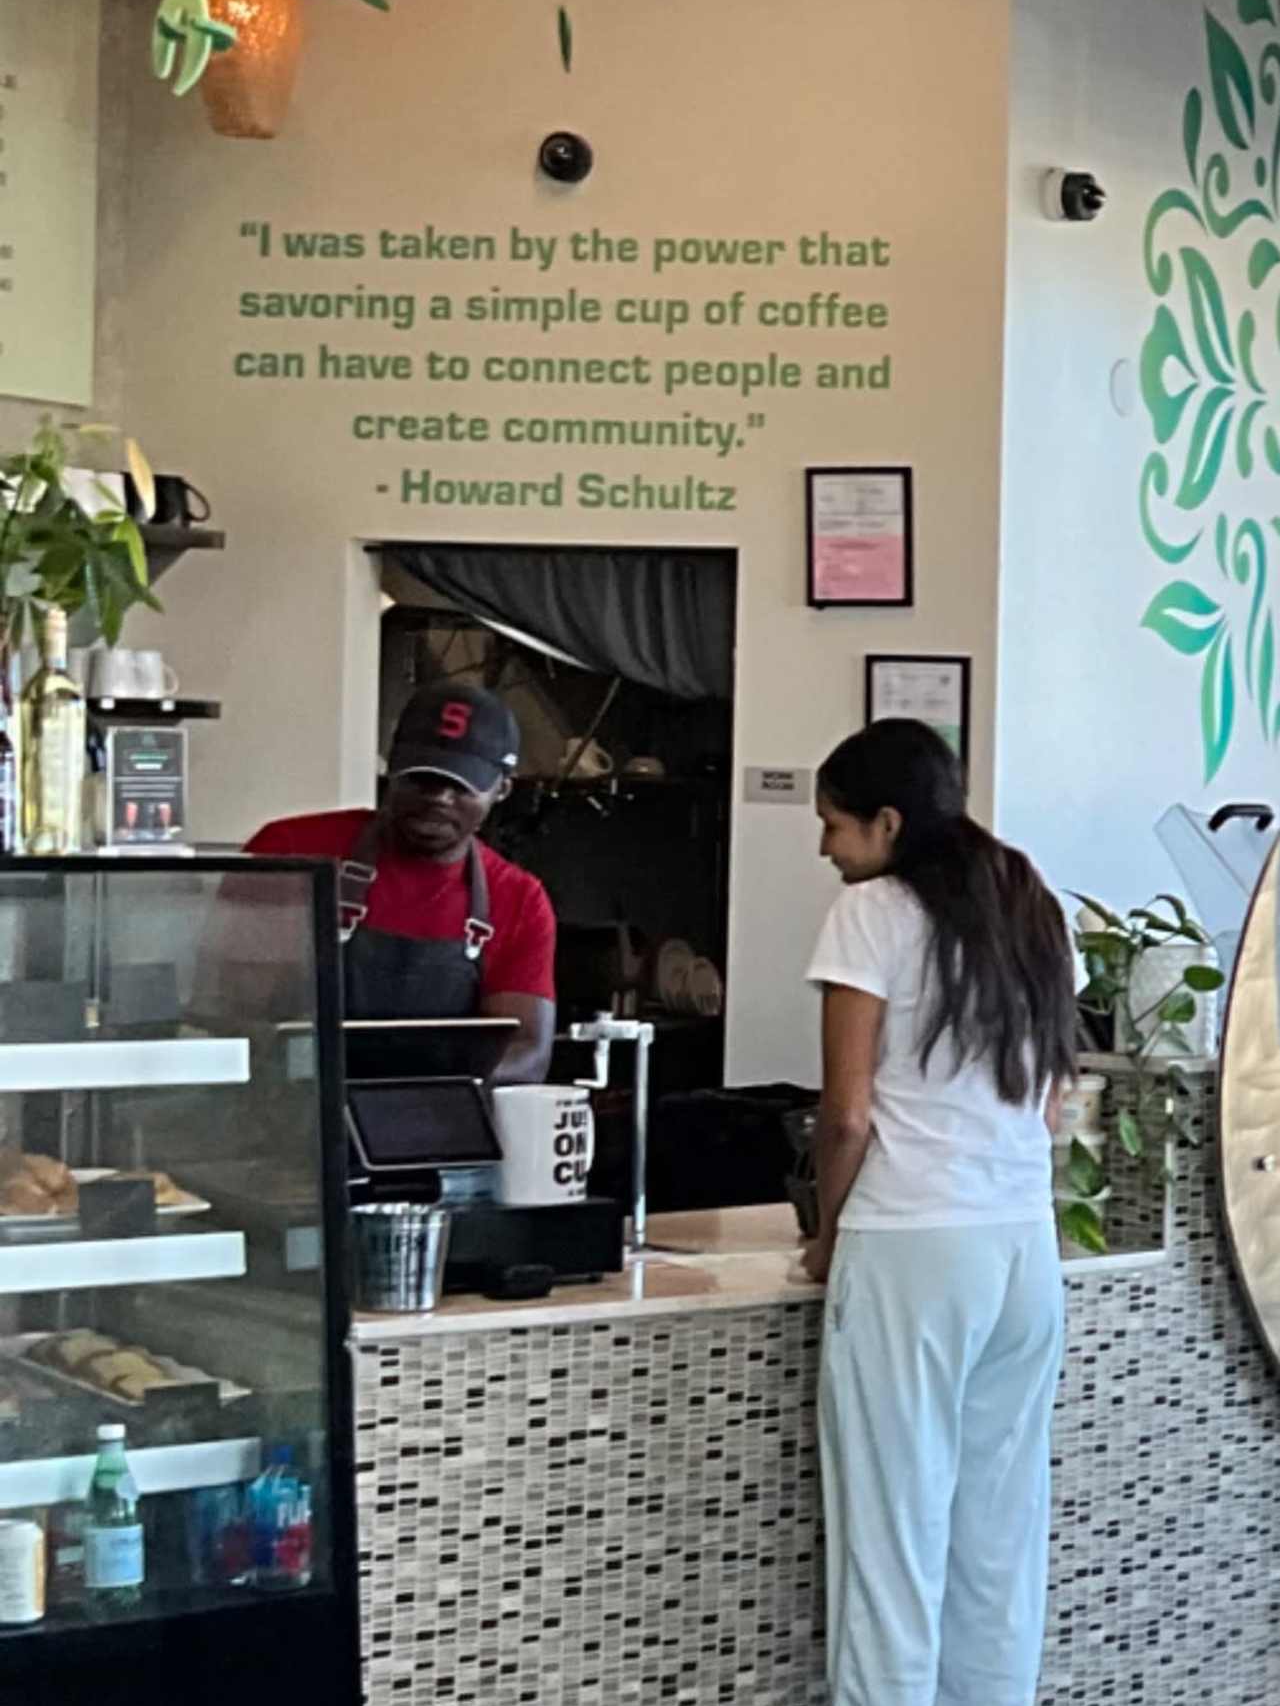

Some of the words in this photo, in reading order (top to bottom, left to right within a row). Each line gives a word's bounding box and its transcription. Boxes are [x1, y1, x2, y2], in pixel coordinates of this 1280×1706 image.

[282, 231, 366, 259] was
[378, 224, 496, 261] taken
[509, 226, 557, 272] by
[569, 228, 639, 263] the
[653, 237, 786, 273] power
[799, 231, 891, 267] that
[239, 283, 415, 330] savoring
[428, 294, 452, 321] a
[465, 285, 602, 332] simple
[615, 296, 690, 335] cup
[703, 291, 746, 326] of
[758, 291, 890, 328] coffee
[234, 351, 305, 379] can
[318, 344, 413, 380] have
[426, 351, 470, 382] to
[483, 354, 652, 385] connect
[664, 352, 802, 397] people
[816, 354, 891, 390] and
[352, 412, 490, 442] create
[400, 468, 563, 507] Howard
[577, 472, 738, 511] Schultz
[438, 700, 473, 740] S
[554, 1111, 588, 1130] JU
